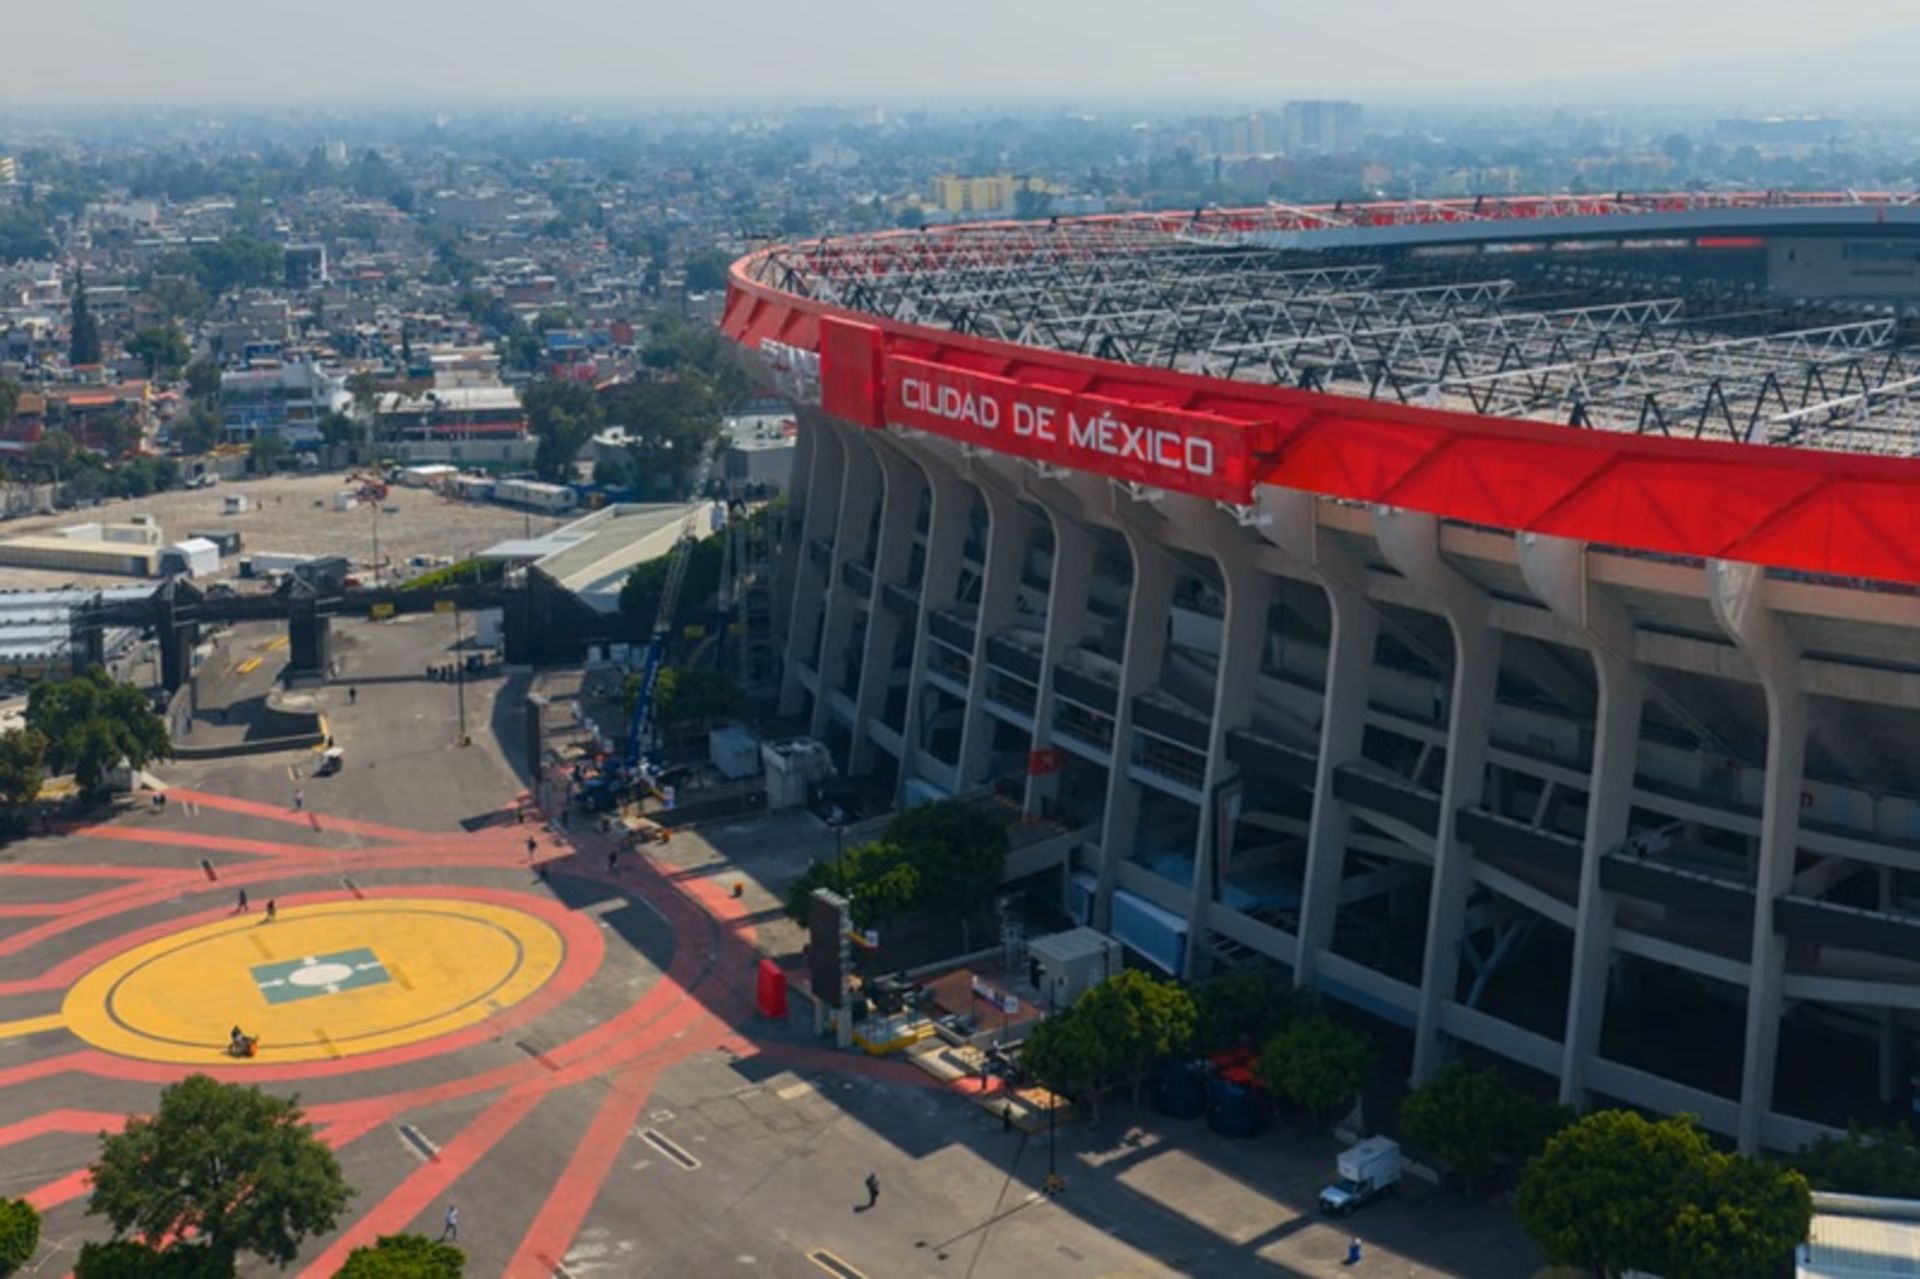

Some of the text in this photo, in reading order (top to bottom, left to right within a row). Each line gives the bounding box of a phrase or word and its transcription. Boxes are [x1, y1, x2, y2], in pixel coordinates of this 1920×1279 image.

[902, 378, 1213, 475] CIUDAD DE MÉXICO
